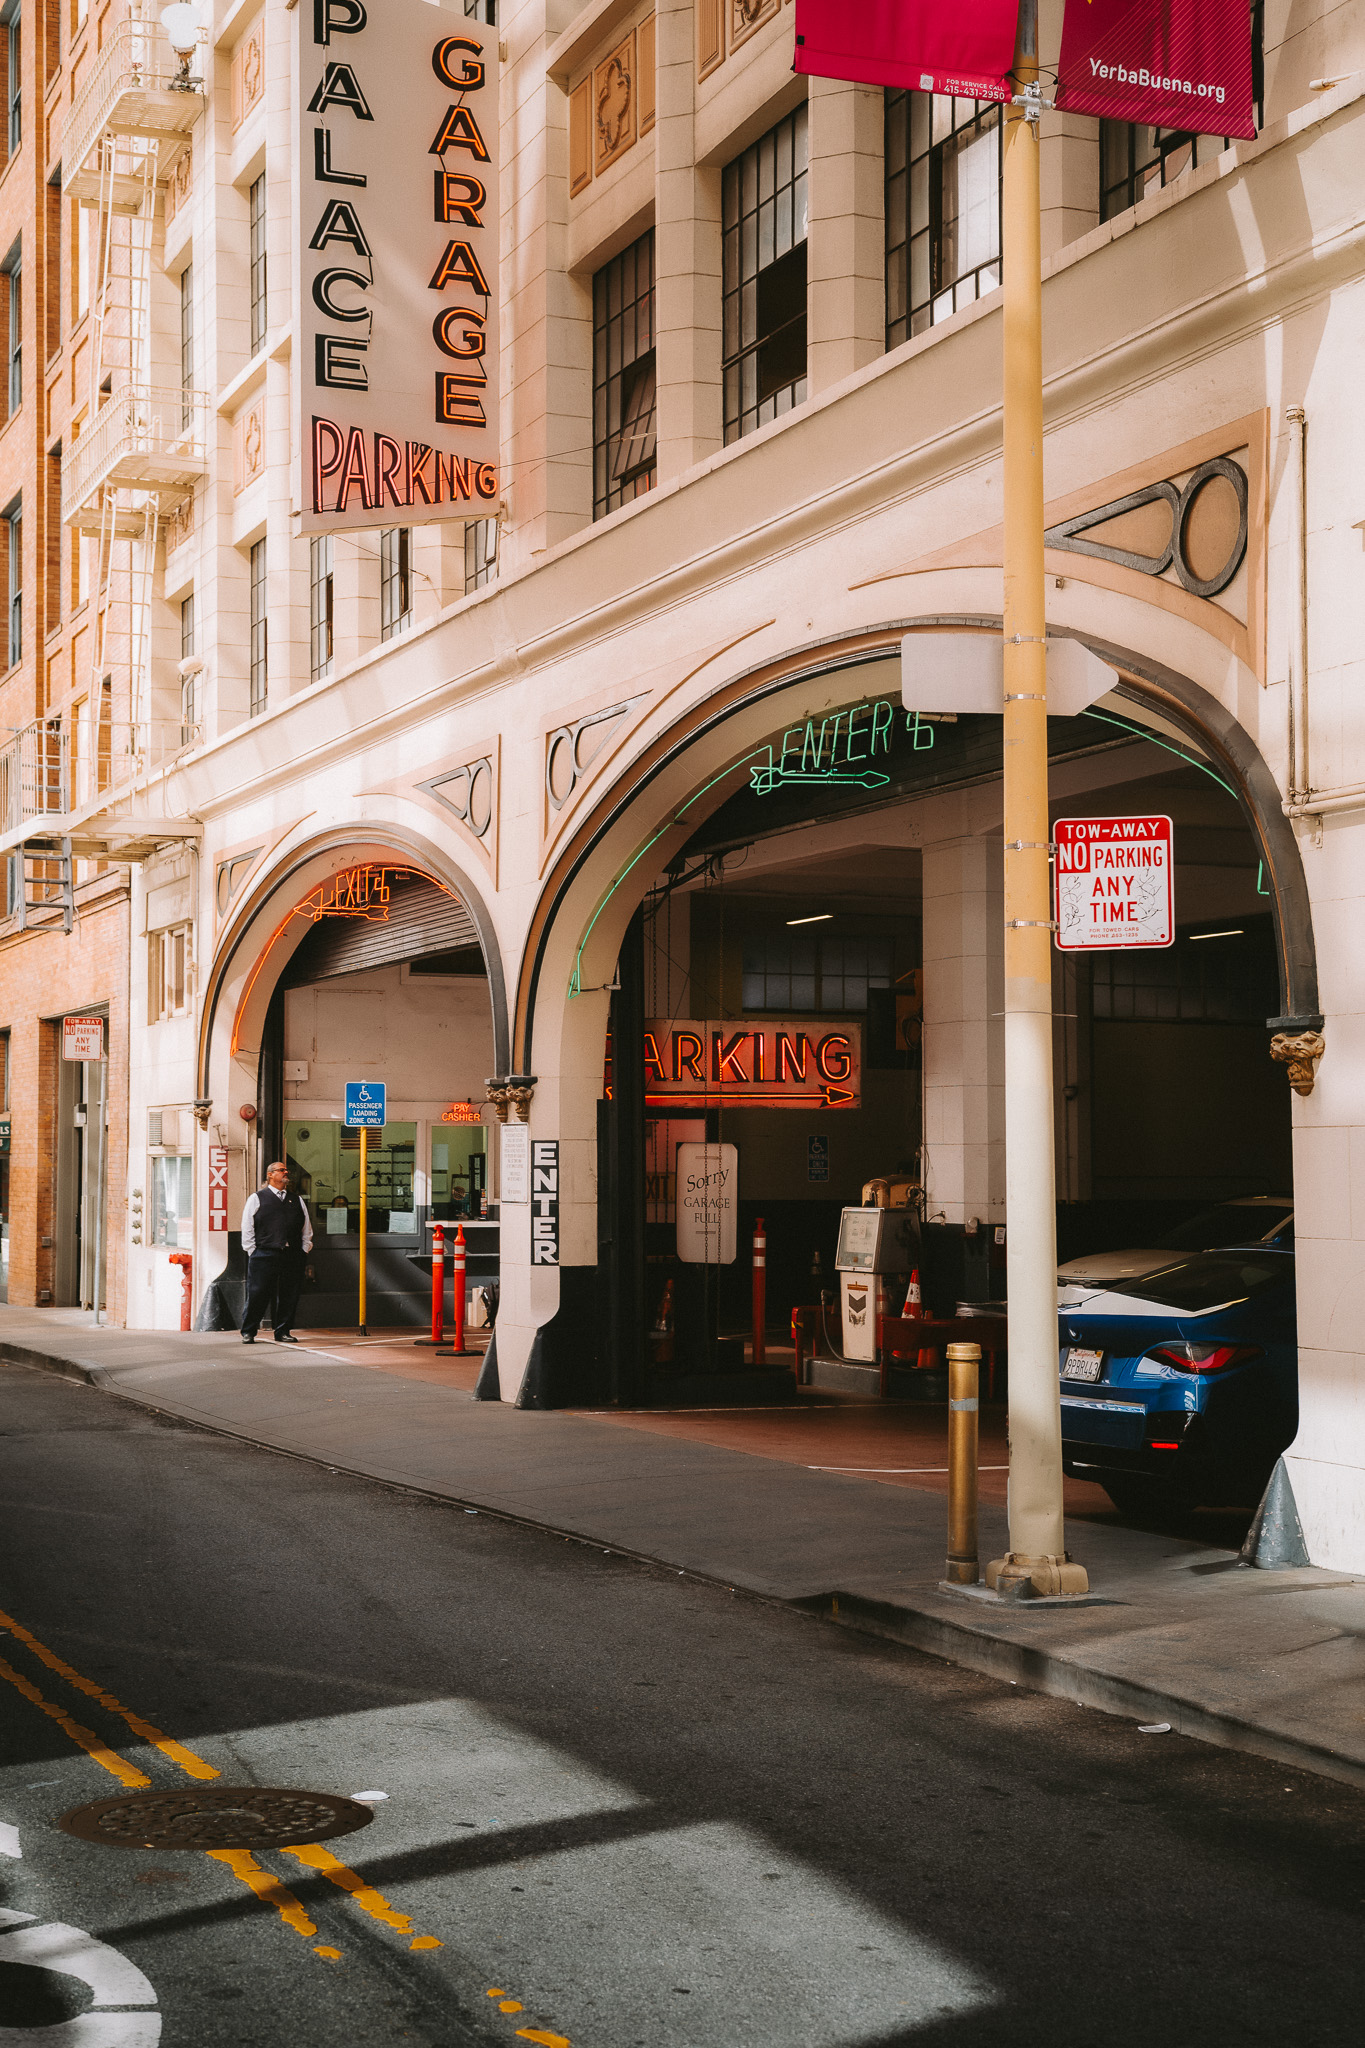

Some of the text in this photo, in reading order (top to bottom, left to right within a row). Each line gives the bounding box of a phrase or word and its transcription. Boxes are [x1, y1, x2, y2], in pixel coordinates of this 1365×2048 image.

[960, 80, 987, 90] SERVICE
[1089, 57, 1225, 104] YerbaBuena.org
[943, 85, 1005, 100] 415-431-2950
[306, 0, 374, 392] PALACE
[427, 36, 492, 428] GARAGE
[311, 415, 498, 514] PARKING
[780, 700, 894, 775] ENTER
[1065, 822, 1160, 839] TOW-AWAY
[1060, 842, 1163, 870] NO PARKING
[336, 865, 375, 910] EXIT
[1092, 875, 1135, 897] ANY
[1090, 901, 1138, 923] TIME
[65, 1024, 99, 1035] NO PARKING
[75, 1036, 90, 1044] ANY
[74, 1044, 91, 1053] TIME
[441, 1112, 481, 1122] CASHIER
[453, 1103, 470, 1112] PAY
[209, 1148, 228, 1230] EXIT
[686, 1168, 730, 1193] Sorry
[533, 1142, 558, 1264] ENTER
[683, 1196, 731, 1209] GARAGE
[694, 1212, 720, 1224] FULL
[1066, 1358, 1099, 1377] 9PBR443
